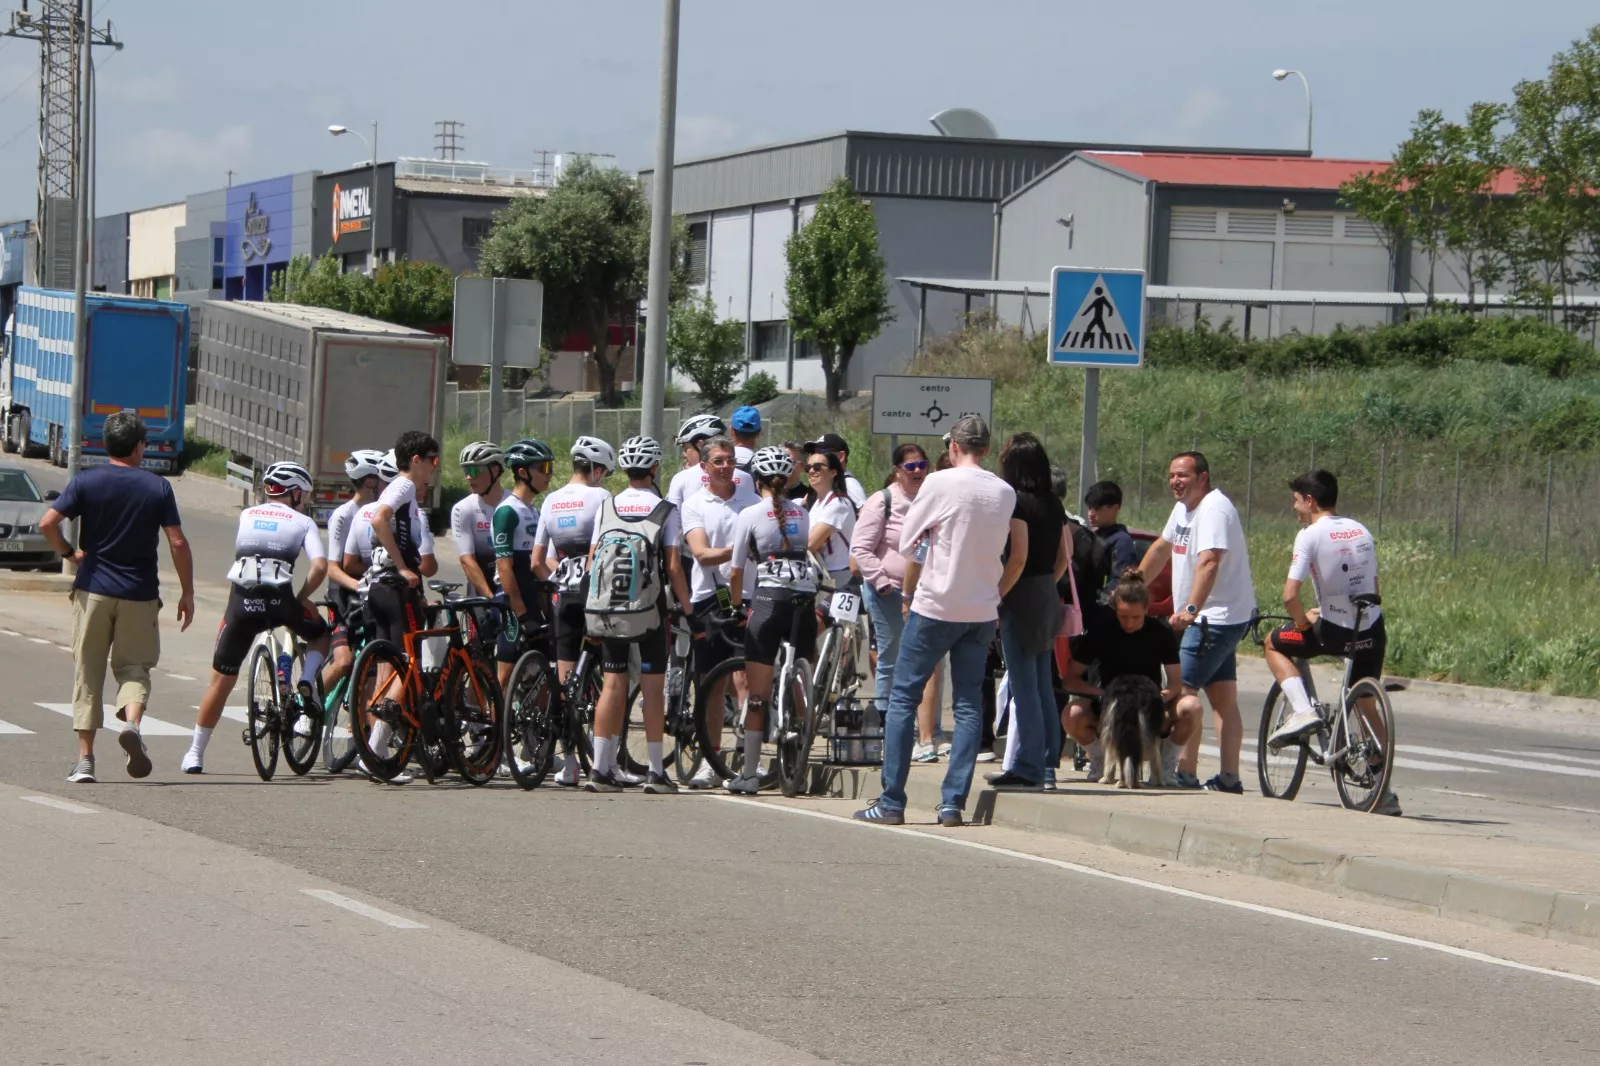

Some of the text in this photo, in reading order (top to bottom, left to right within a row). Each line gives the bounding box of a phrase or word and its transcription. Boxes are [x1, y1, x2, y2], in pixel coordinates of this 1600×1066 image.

[552, 501, 584, 509] ecotisa
[249, 509, 293, 519] ecotisa
[1330, 529, 1364, 540] ecotisa
[838, 594, 853, 611] 25
[1279, 629, 1303, 641] ecotisa
